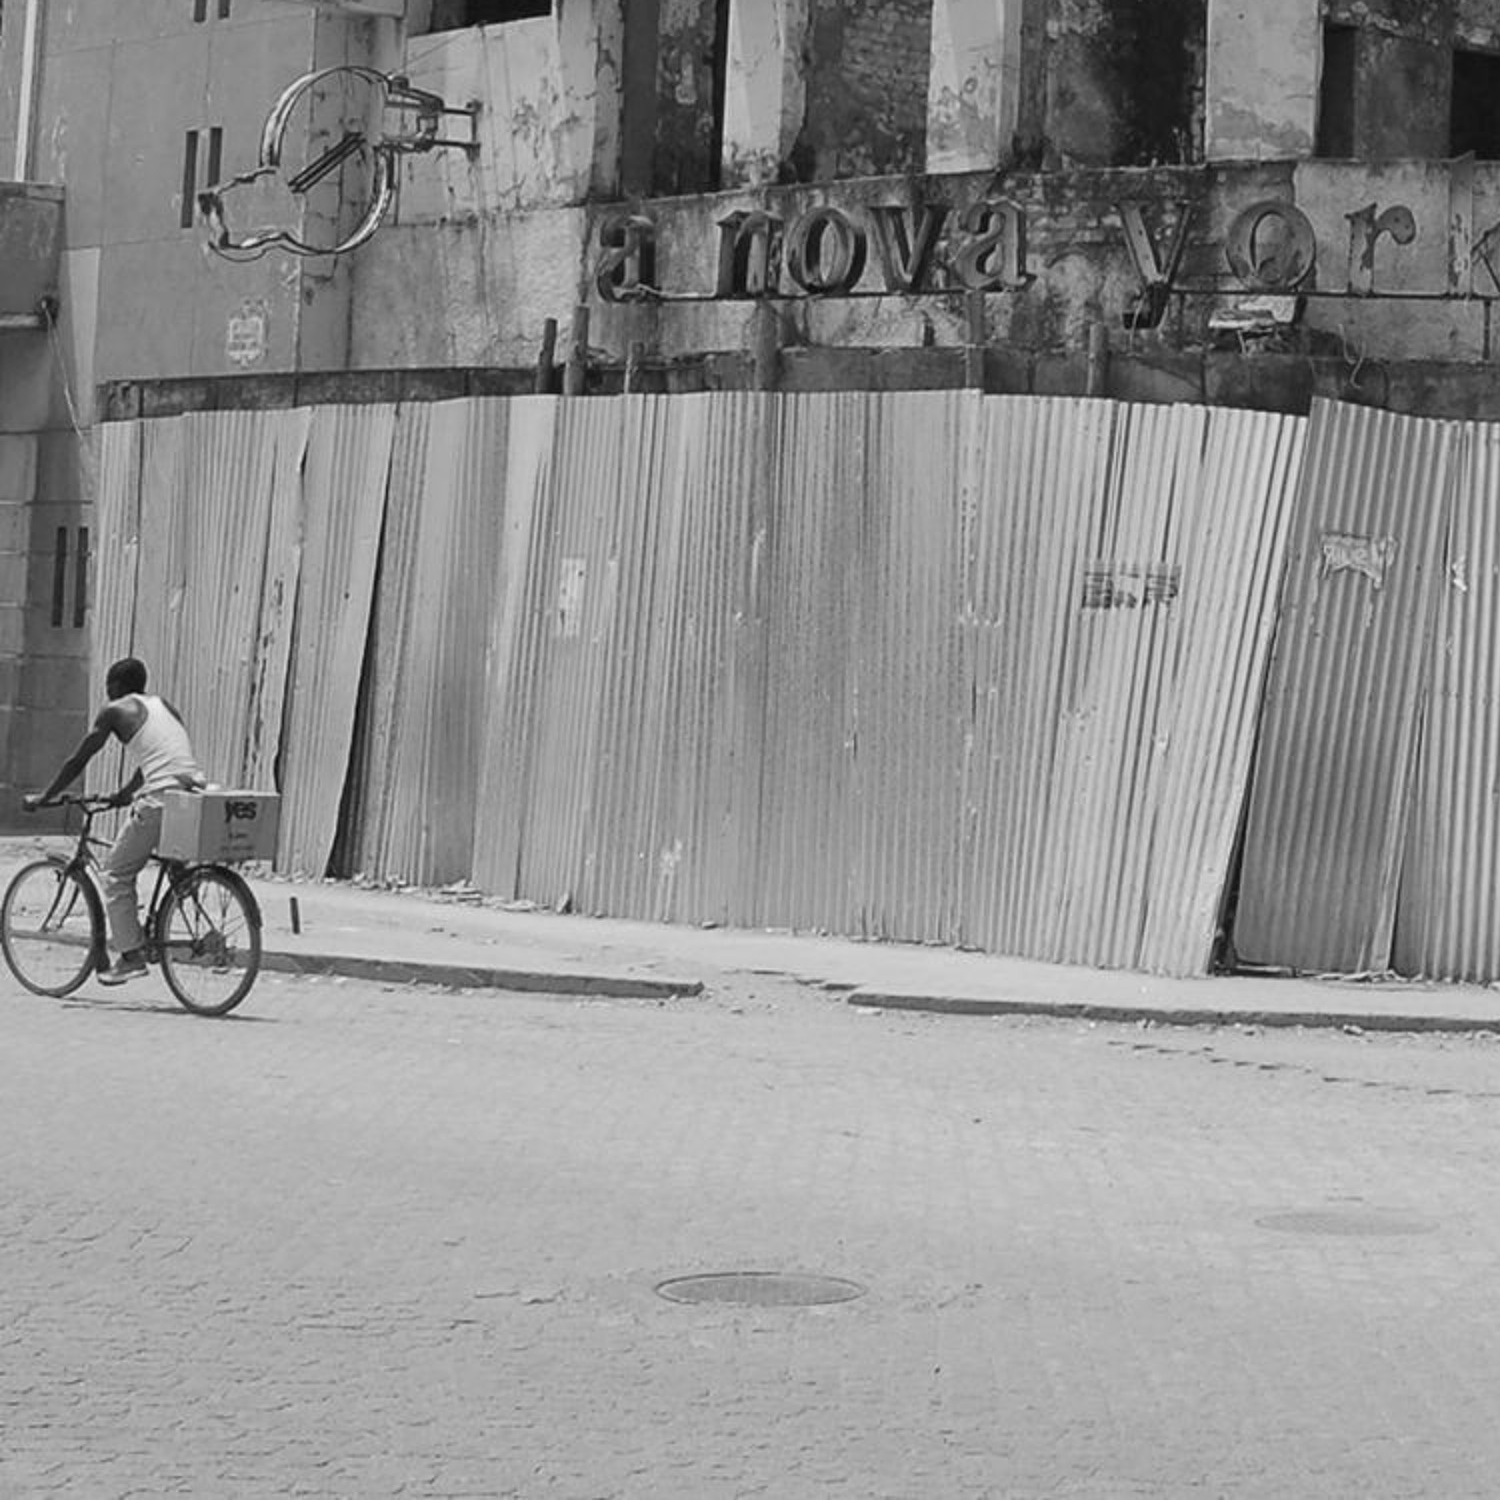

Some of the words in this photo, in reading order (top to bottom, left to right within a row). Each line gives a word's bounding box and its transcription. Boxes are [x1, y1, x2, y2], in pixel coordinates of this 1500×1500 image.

[597, 214, 661, 300] a
[715, 201, 1037, 299] nova
[225, 801, 257, 824] yes
